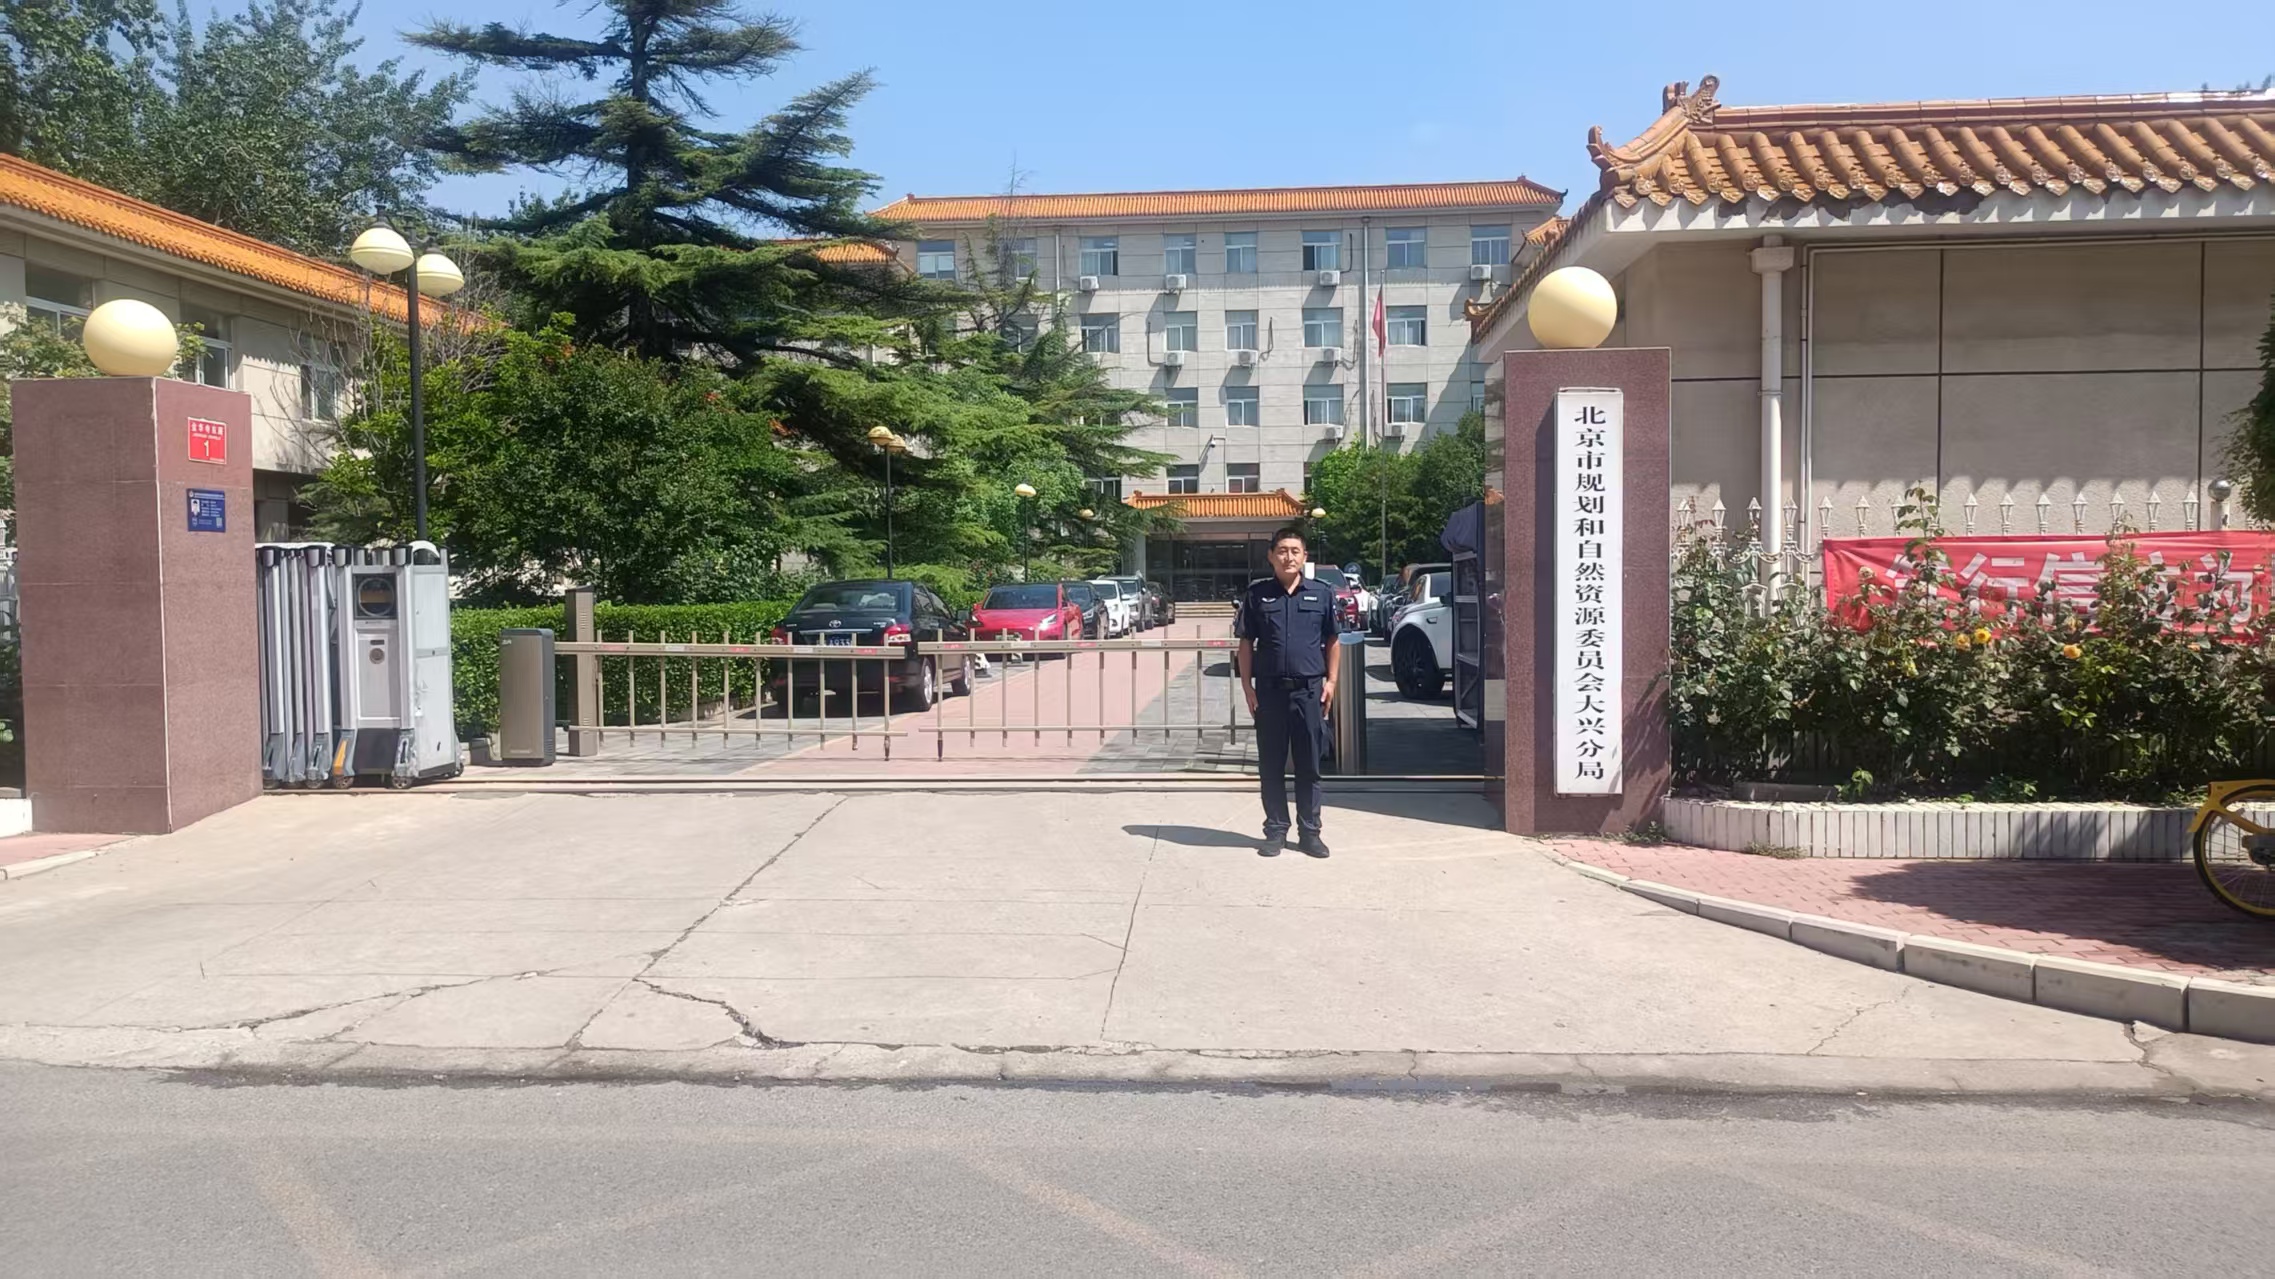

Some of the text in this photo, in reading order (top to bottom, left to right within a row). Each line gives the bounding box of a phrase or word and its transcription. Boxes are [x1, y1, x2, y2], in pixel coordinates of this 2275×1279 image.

[203, 440, 209, 457] 1
[1573, 406, 1606, 781] 北京市规划和自然资源委员会大兴分局
